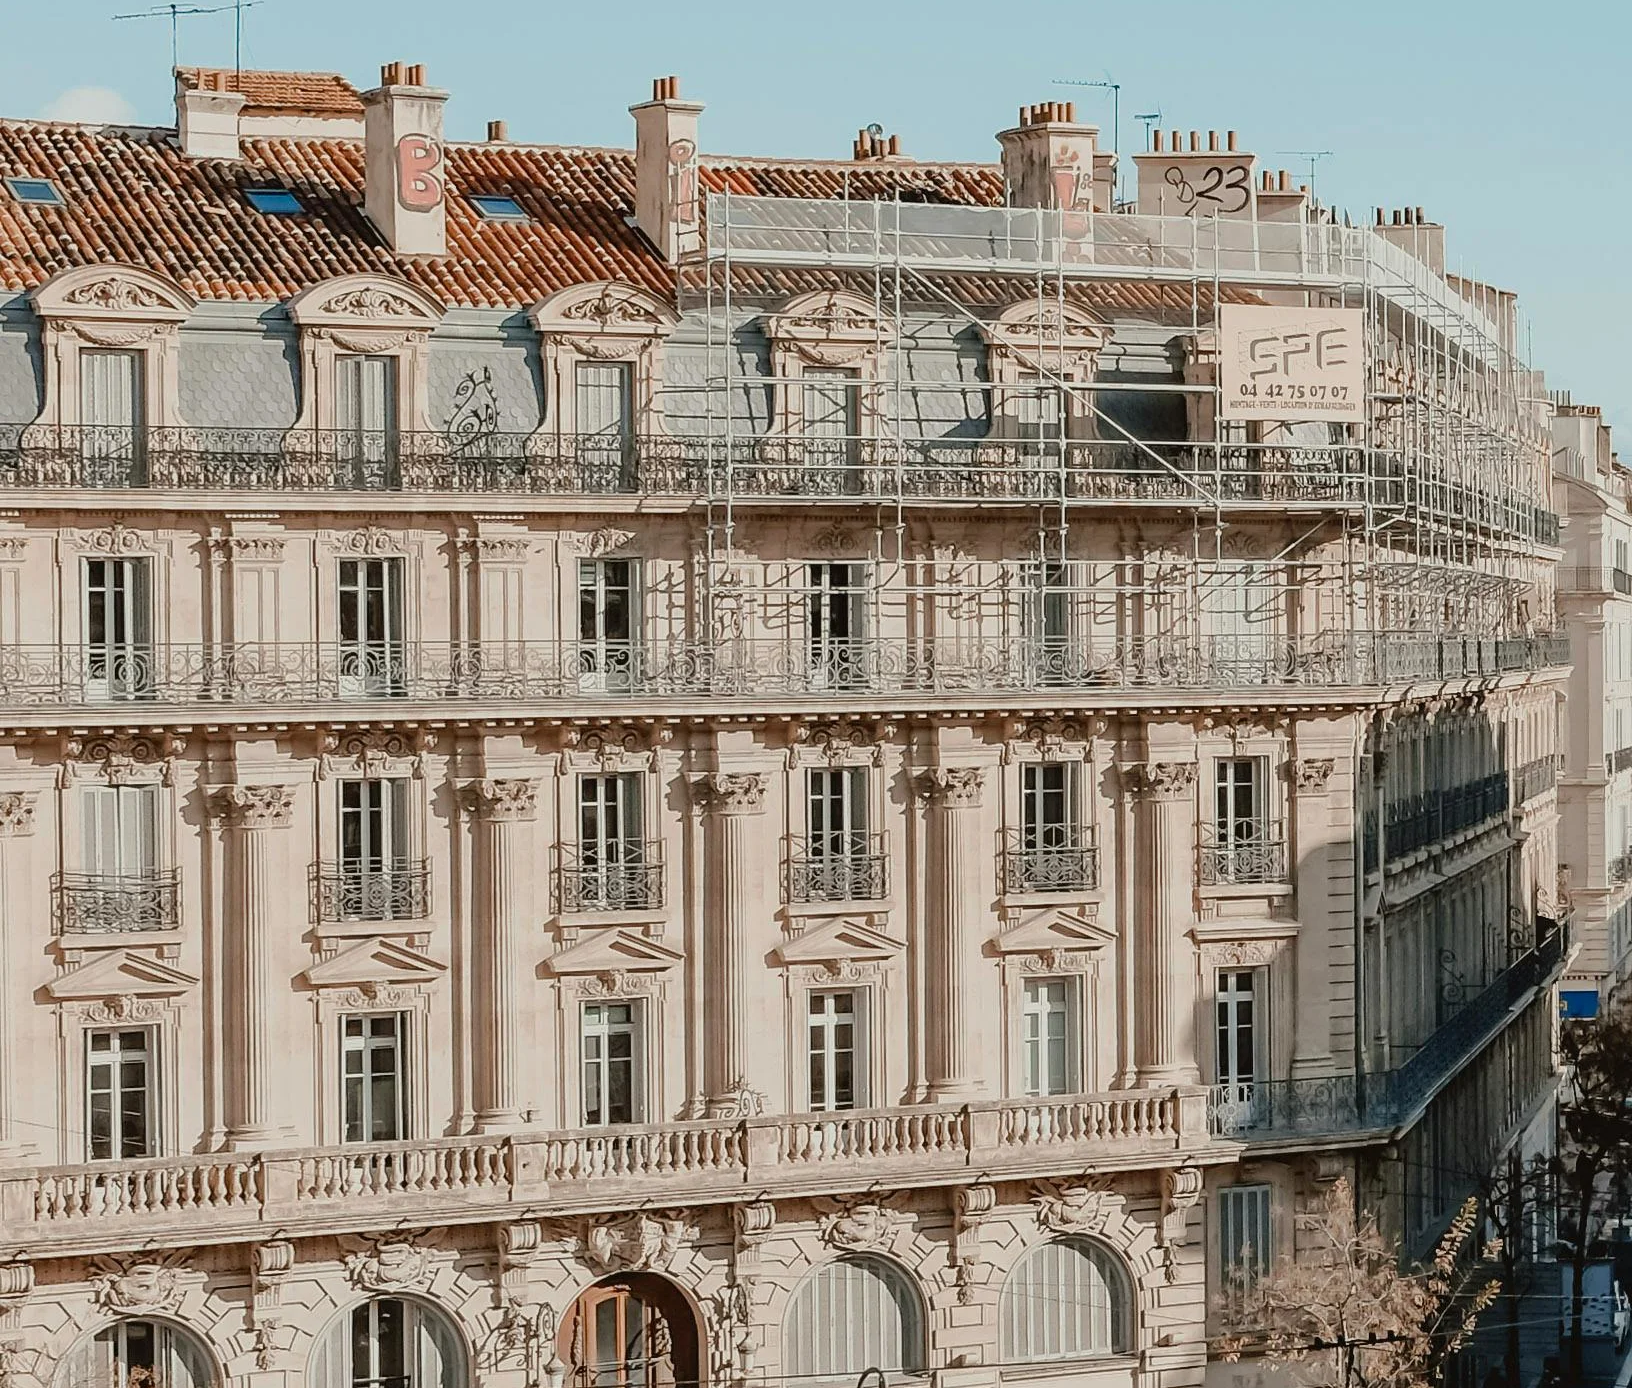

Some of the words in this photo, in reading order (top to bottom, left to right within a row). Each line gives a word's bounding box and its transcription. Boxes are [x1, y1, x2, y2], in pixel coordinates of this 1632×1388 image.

[1240, 383, 1257, 397] 04
[1265, 383, 1283, 398] 42
[1287, 385, 1305, 399] 75
[1309, 385, 1326, 400] 07
[1331, 386, 1348, 400] 07
